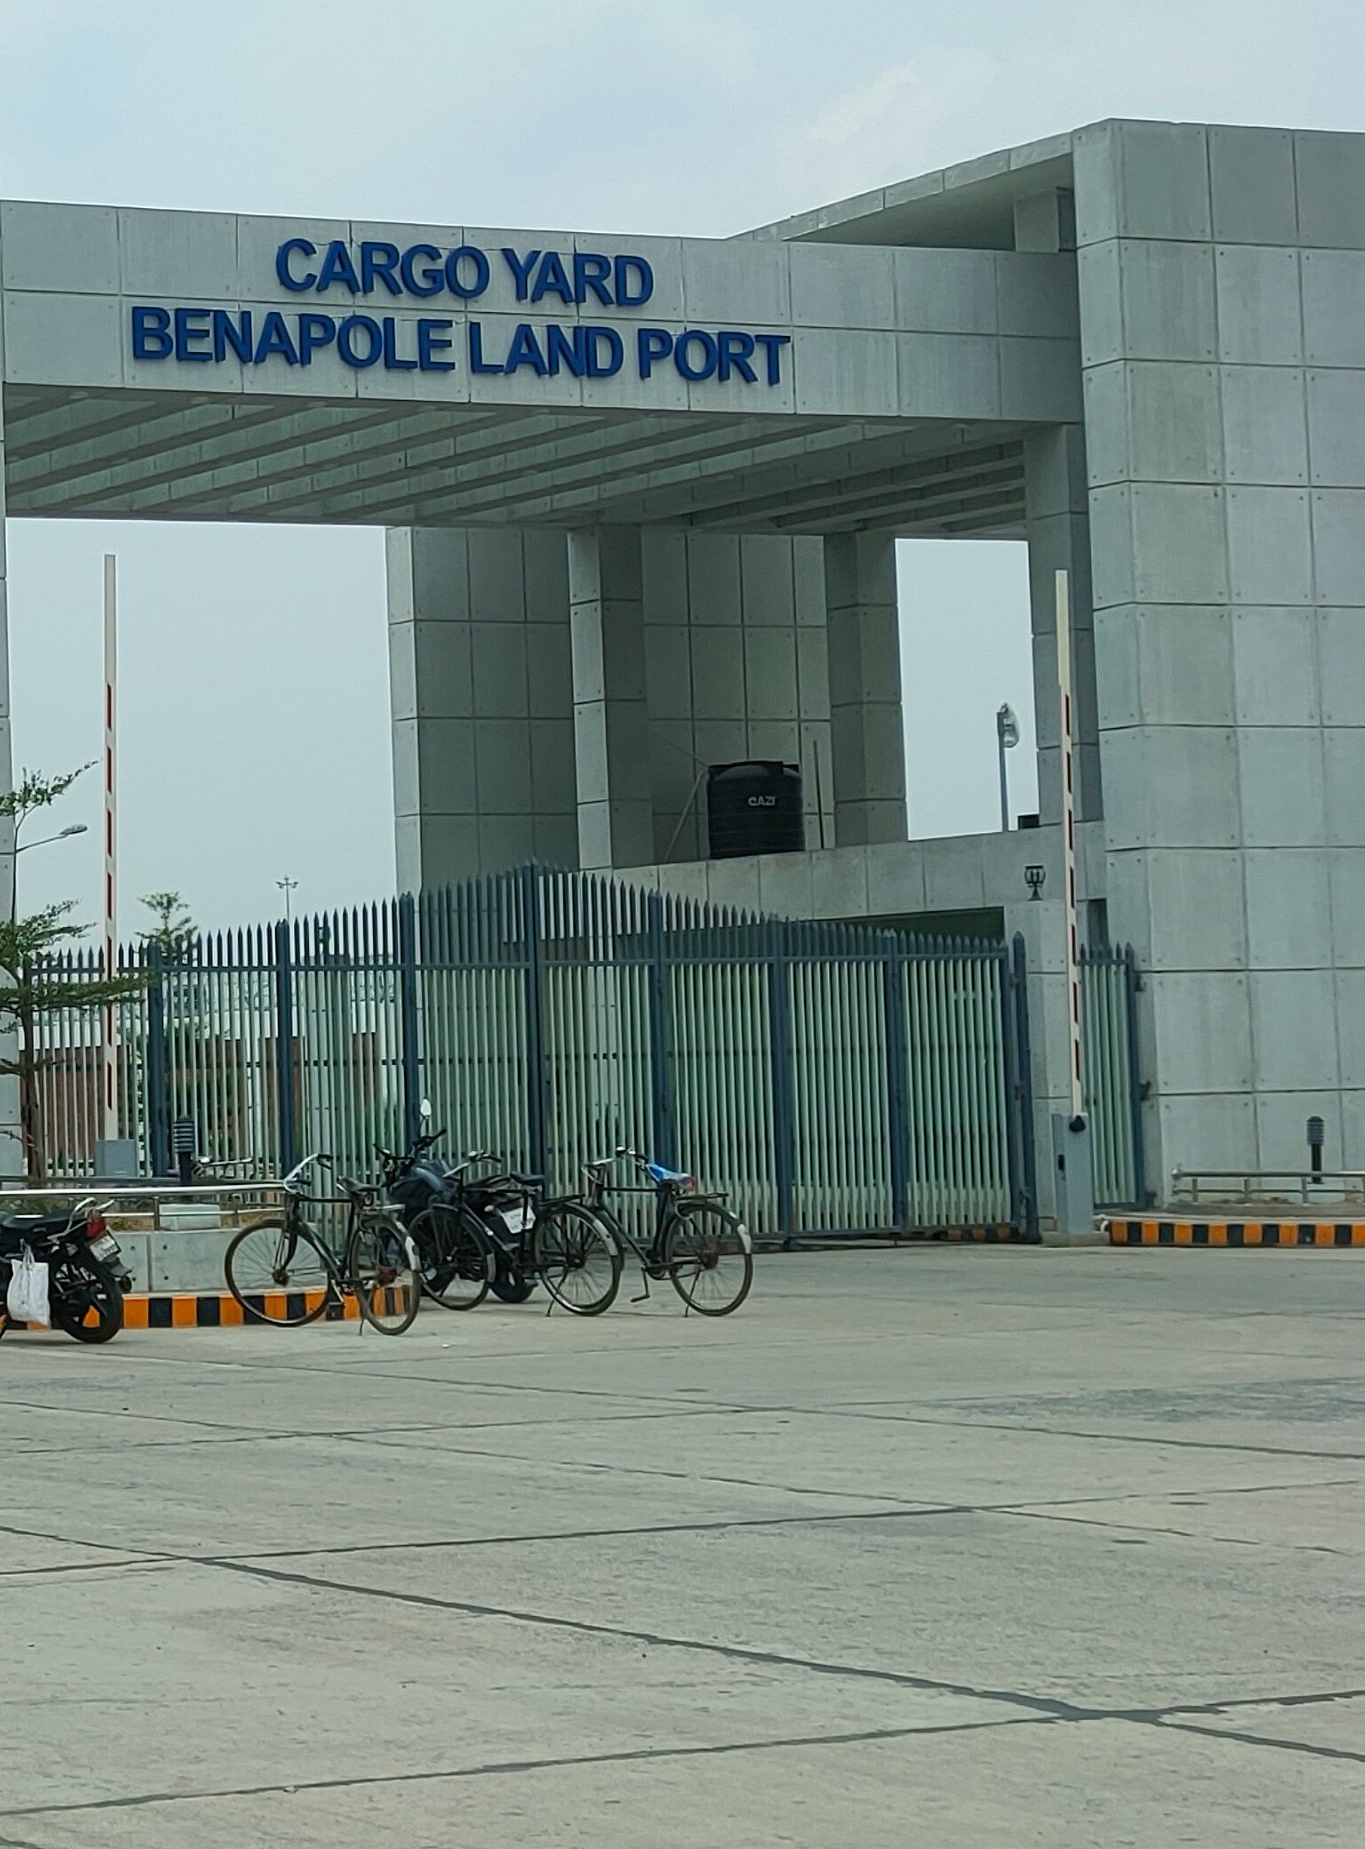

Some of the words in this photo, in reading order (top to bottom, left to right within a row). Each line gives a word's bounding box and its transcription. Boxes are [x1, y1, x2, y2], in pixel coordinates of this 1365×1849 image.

[275, 237, 489, 299] CARGO
[504, 248, 654, 307] YARD
[131, 306, 455, 371] BENAPOLE
[469, 321, 624, 378] LAND
[639, 328, 792, 386] PORT
